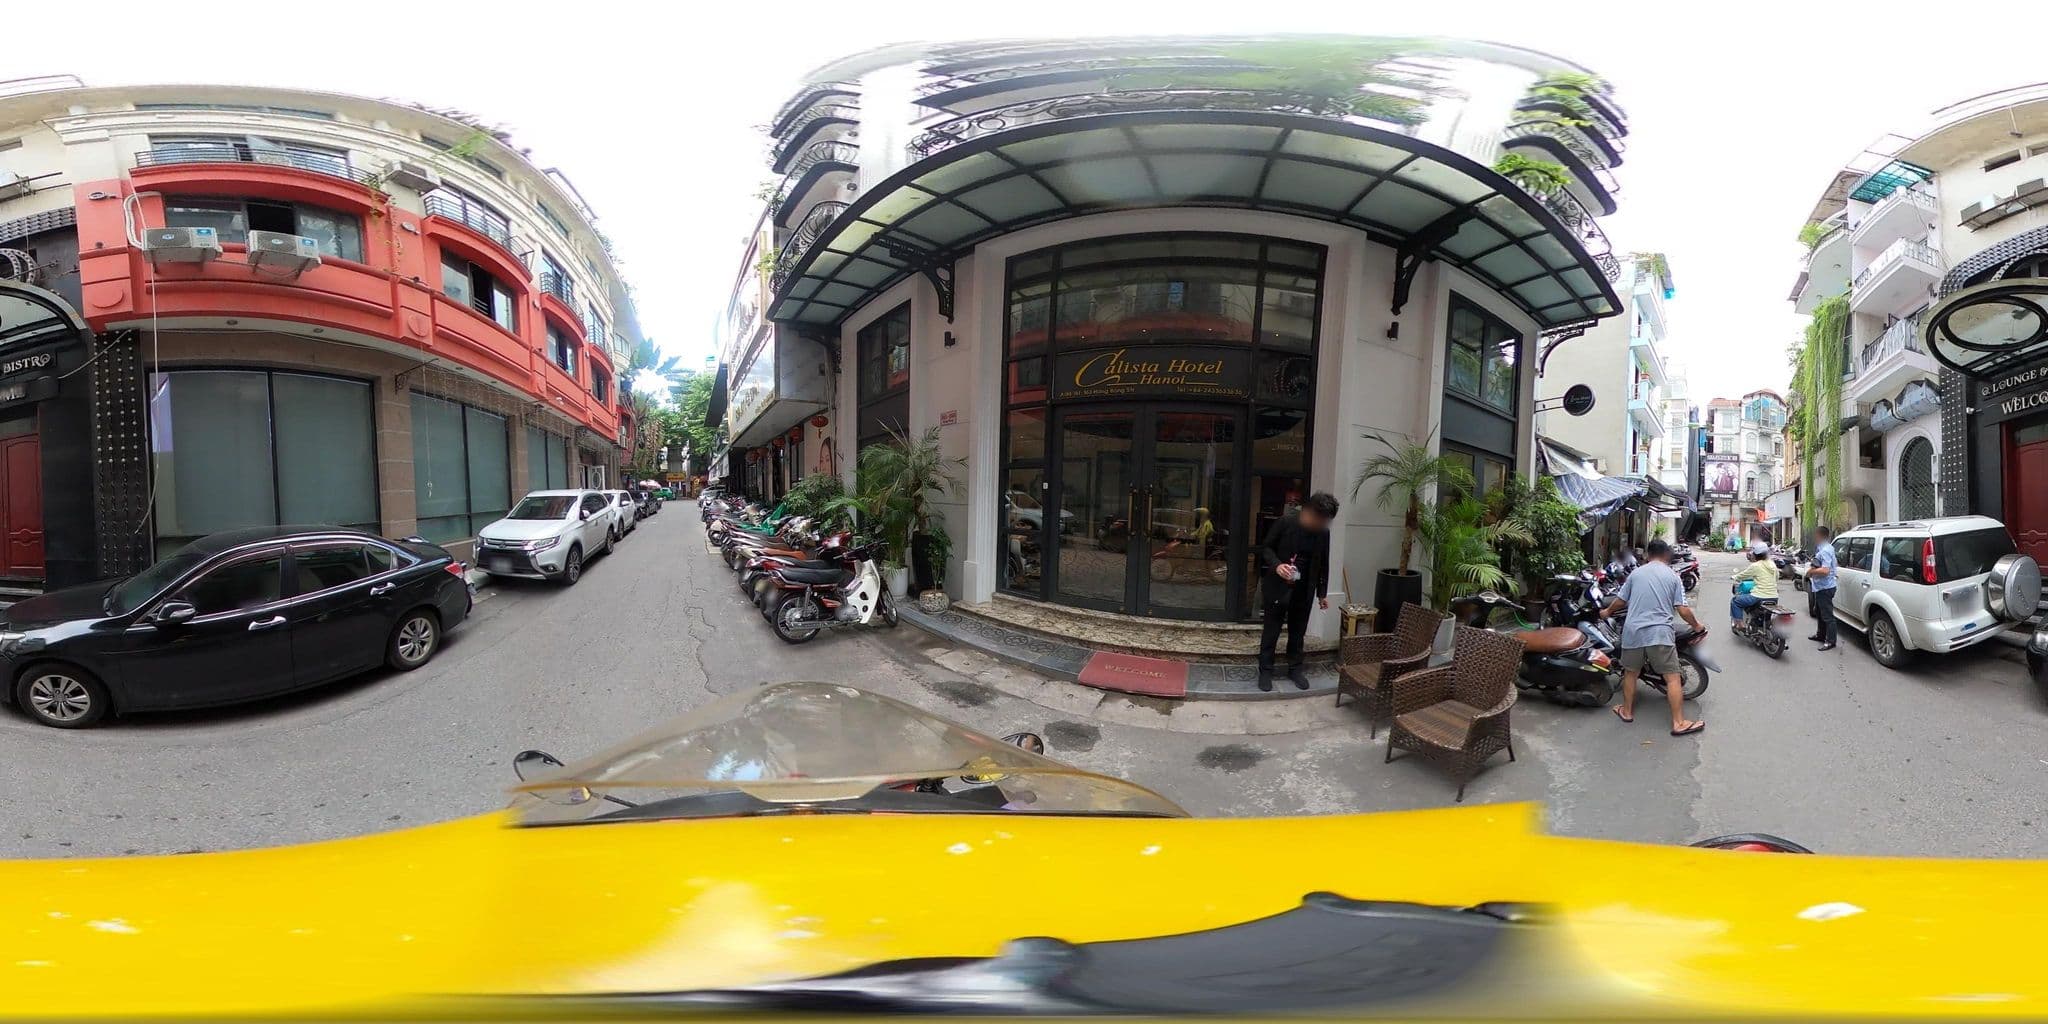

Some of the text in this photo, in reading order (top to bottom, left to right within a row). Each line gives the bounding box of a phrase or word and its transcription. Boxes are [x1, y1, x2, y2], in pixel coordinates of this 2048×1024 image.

[3, 353, 51, 374] BISTRO
[1074, 348, 1224, 388] Calista Hotel
[1140, 374, 1186, 385] Hanoi
[1992, 370, 2037, 392] LOUNGE
[1104, 664, 1168, 678] WELCOME
